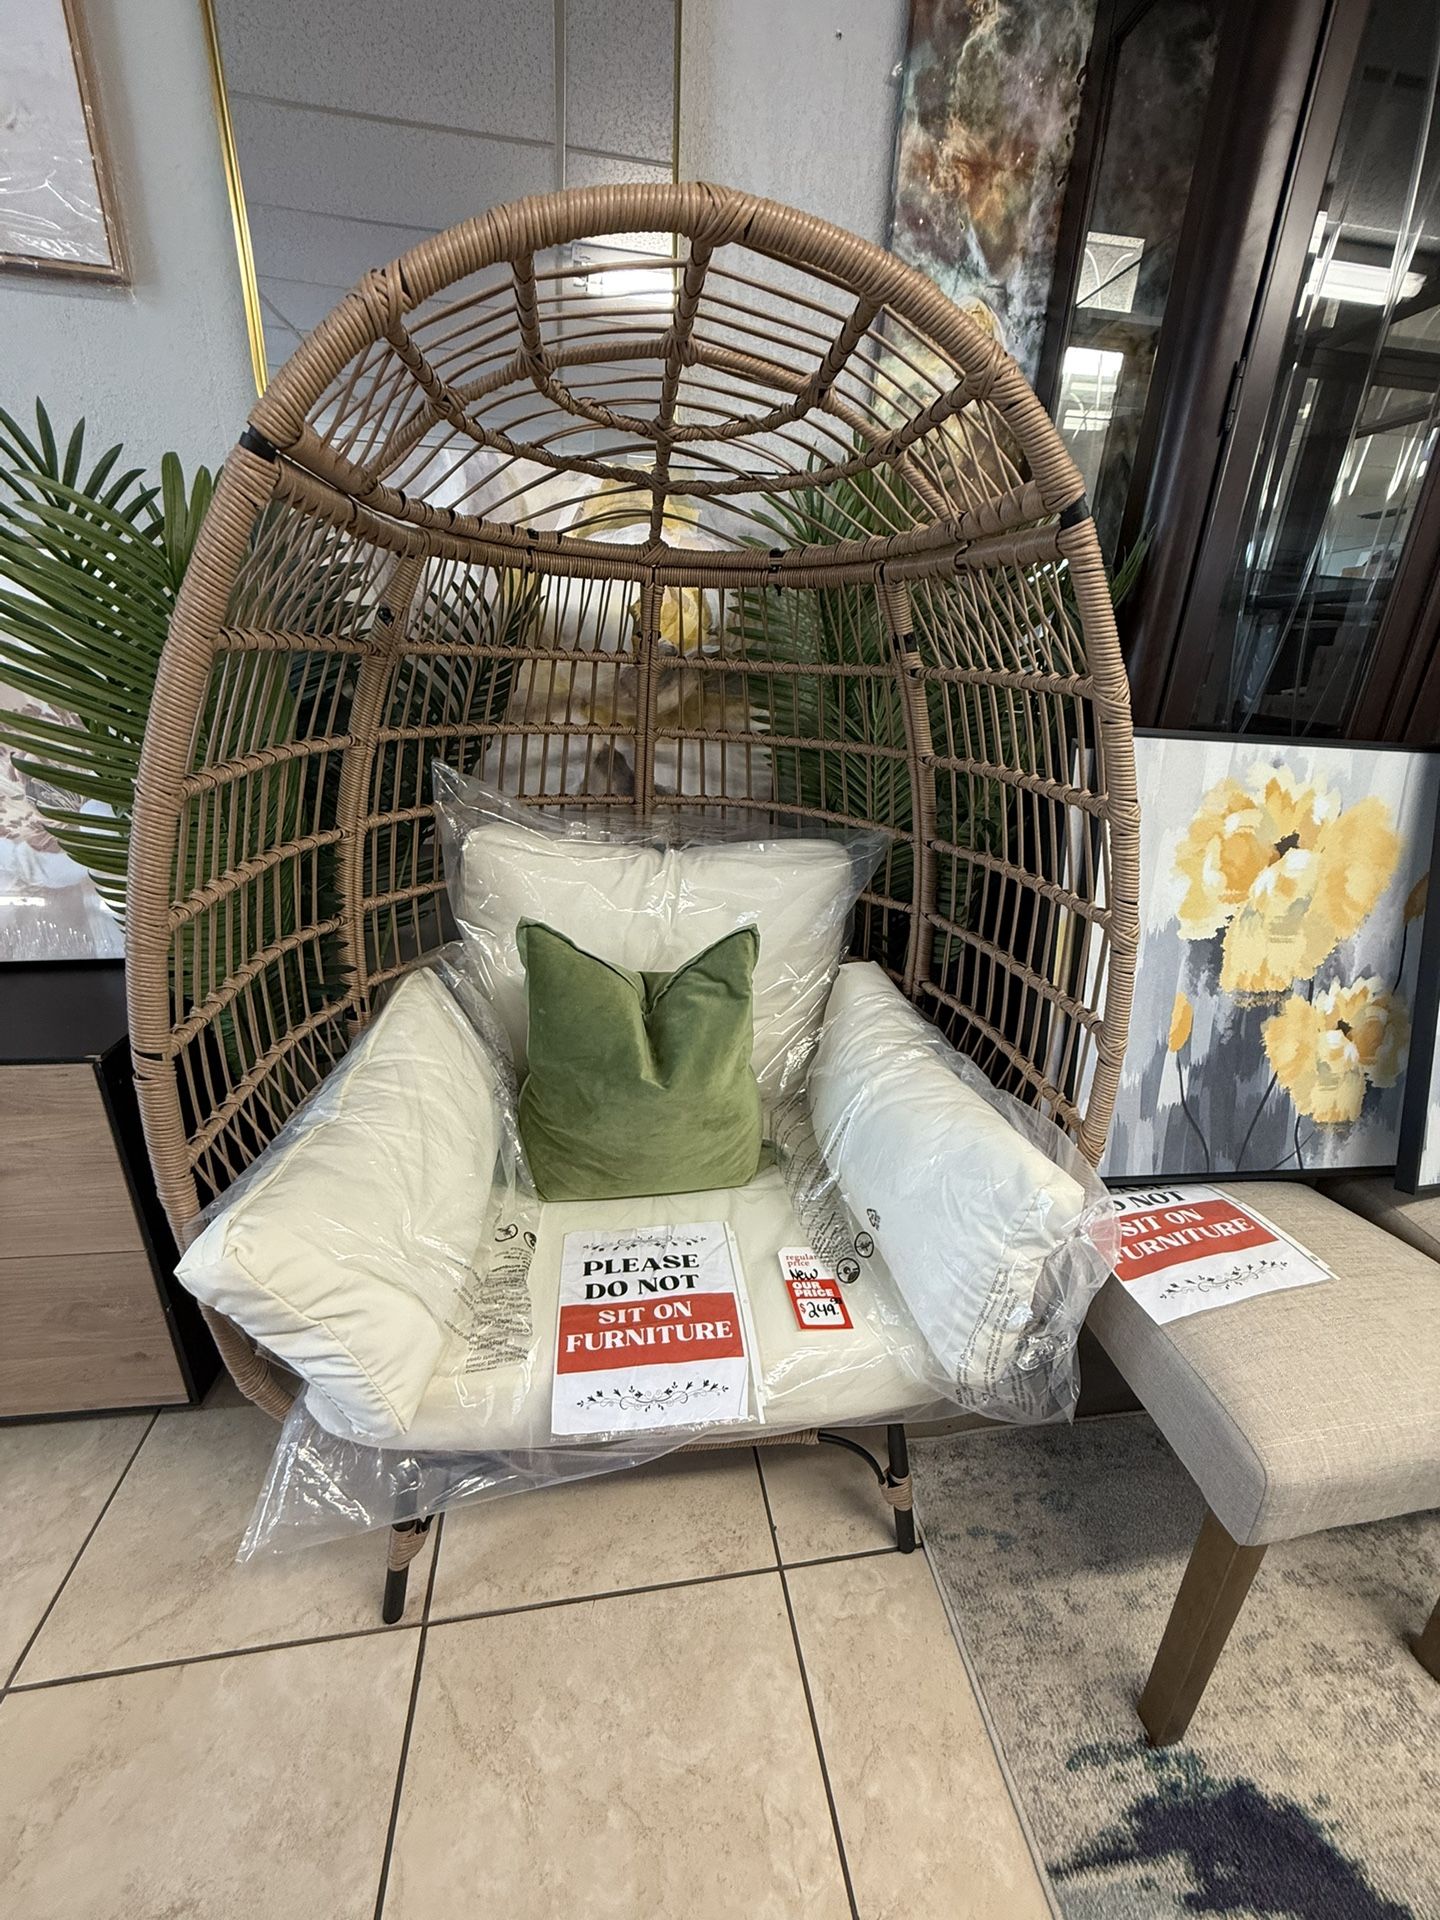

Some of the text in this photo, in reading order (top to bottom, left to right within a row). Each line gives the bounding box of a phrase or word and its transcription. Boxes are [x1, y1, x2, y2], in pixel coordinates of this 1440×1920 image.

[1127, 1190, 1186, 1208] NOT
[1120, 1208, 1205, 1238] SIT ON
[582, 1253, 700, 1277] PLEASE
[785, 1253, 818, 1262] regular
[787, 1260, 811, 1268] price
[585, 1273, 699, 1300] DO NOT
[791, 1281, 821, 1290] OUR
[793, 1288, 835, 1298] PRICE
[598, 1300, 693, 1325] SIT ON
[565, 1320, 734, 1354] FURNITURE
